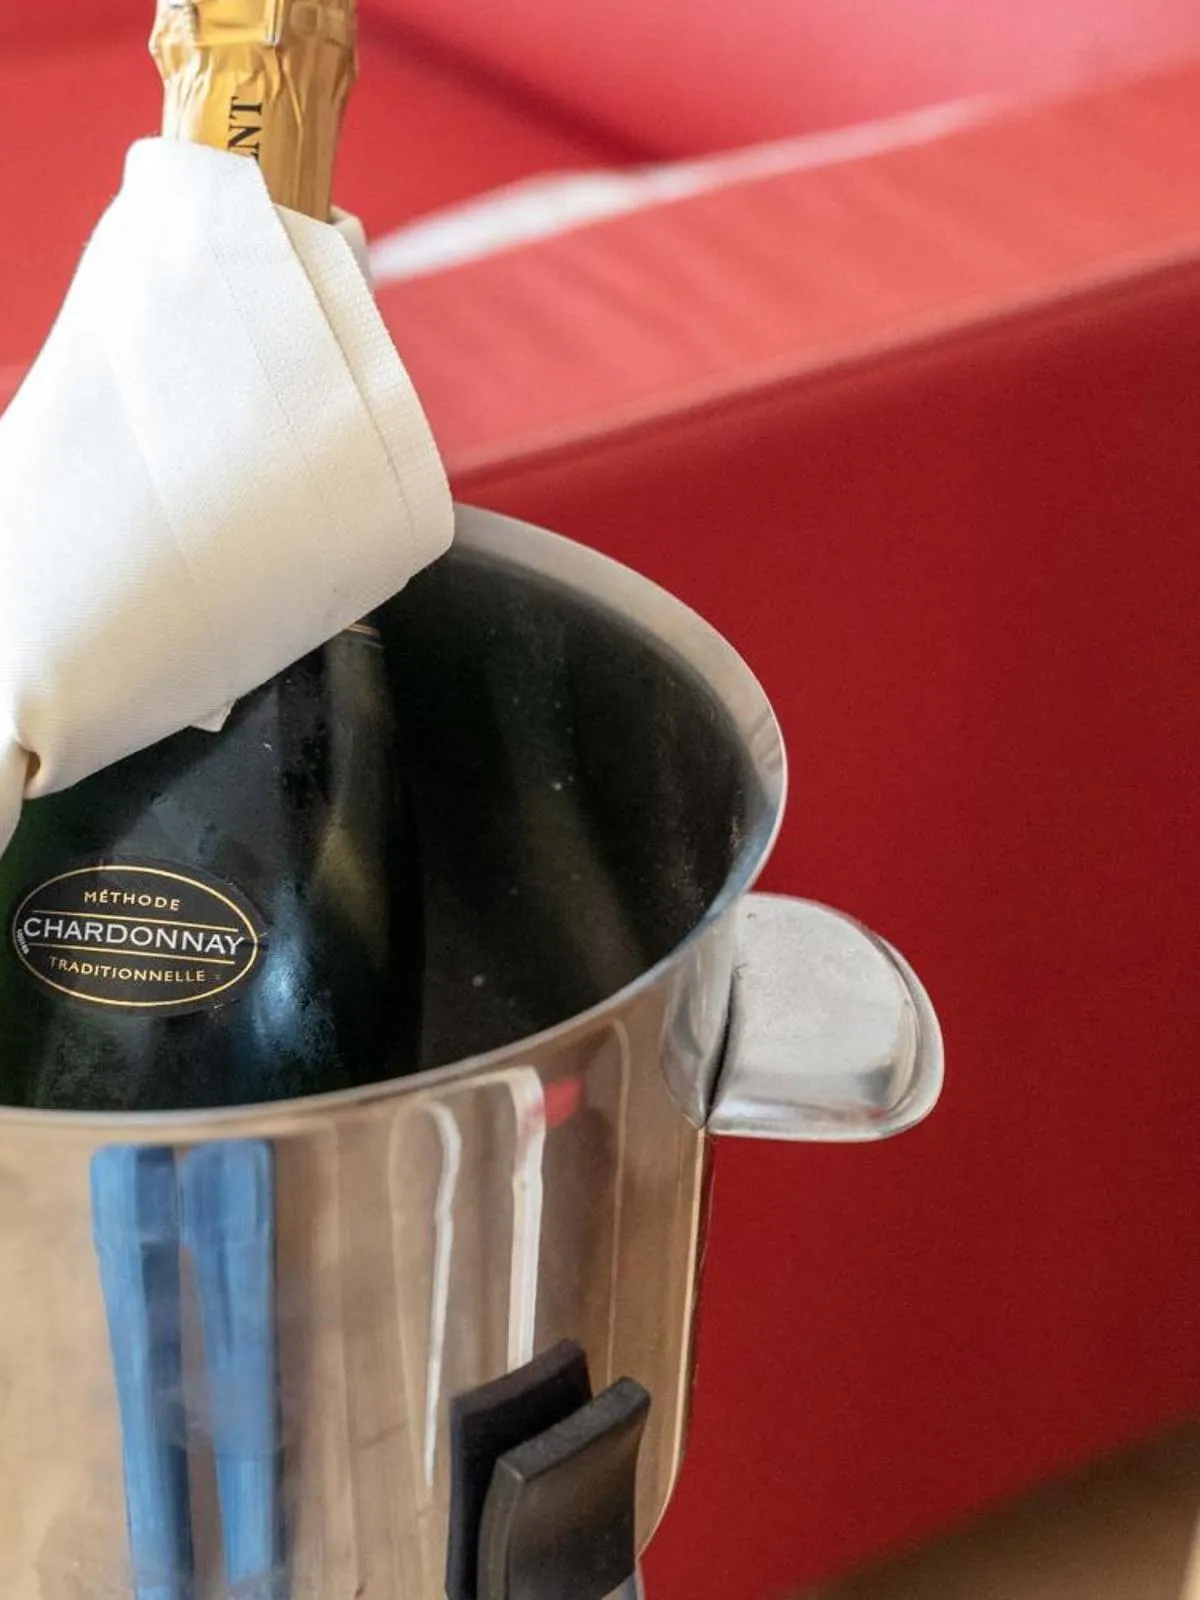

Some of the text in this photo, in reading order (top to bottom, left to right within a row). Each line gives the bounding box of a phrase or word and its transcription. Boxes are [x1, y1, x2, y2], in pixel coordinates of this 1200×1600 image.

[228, 96, 263, 161] NT
[83, 889, 181, 911] MÉTHODE
[23, 917, 244, 955] CHARDONNAY
[50, 957, 206, 982] TRADITIONNELLE
